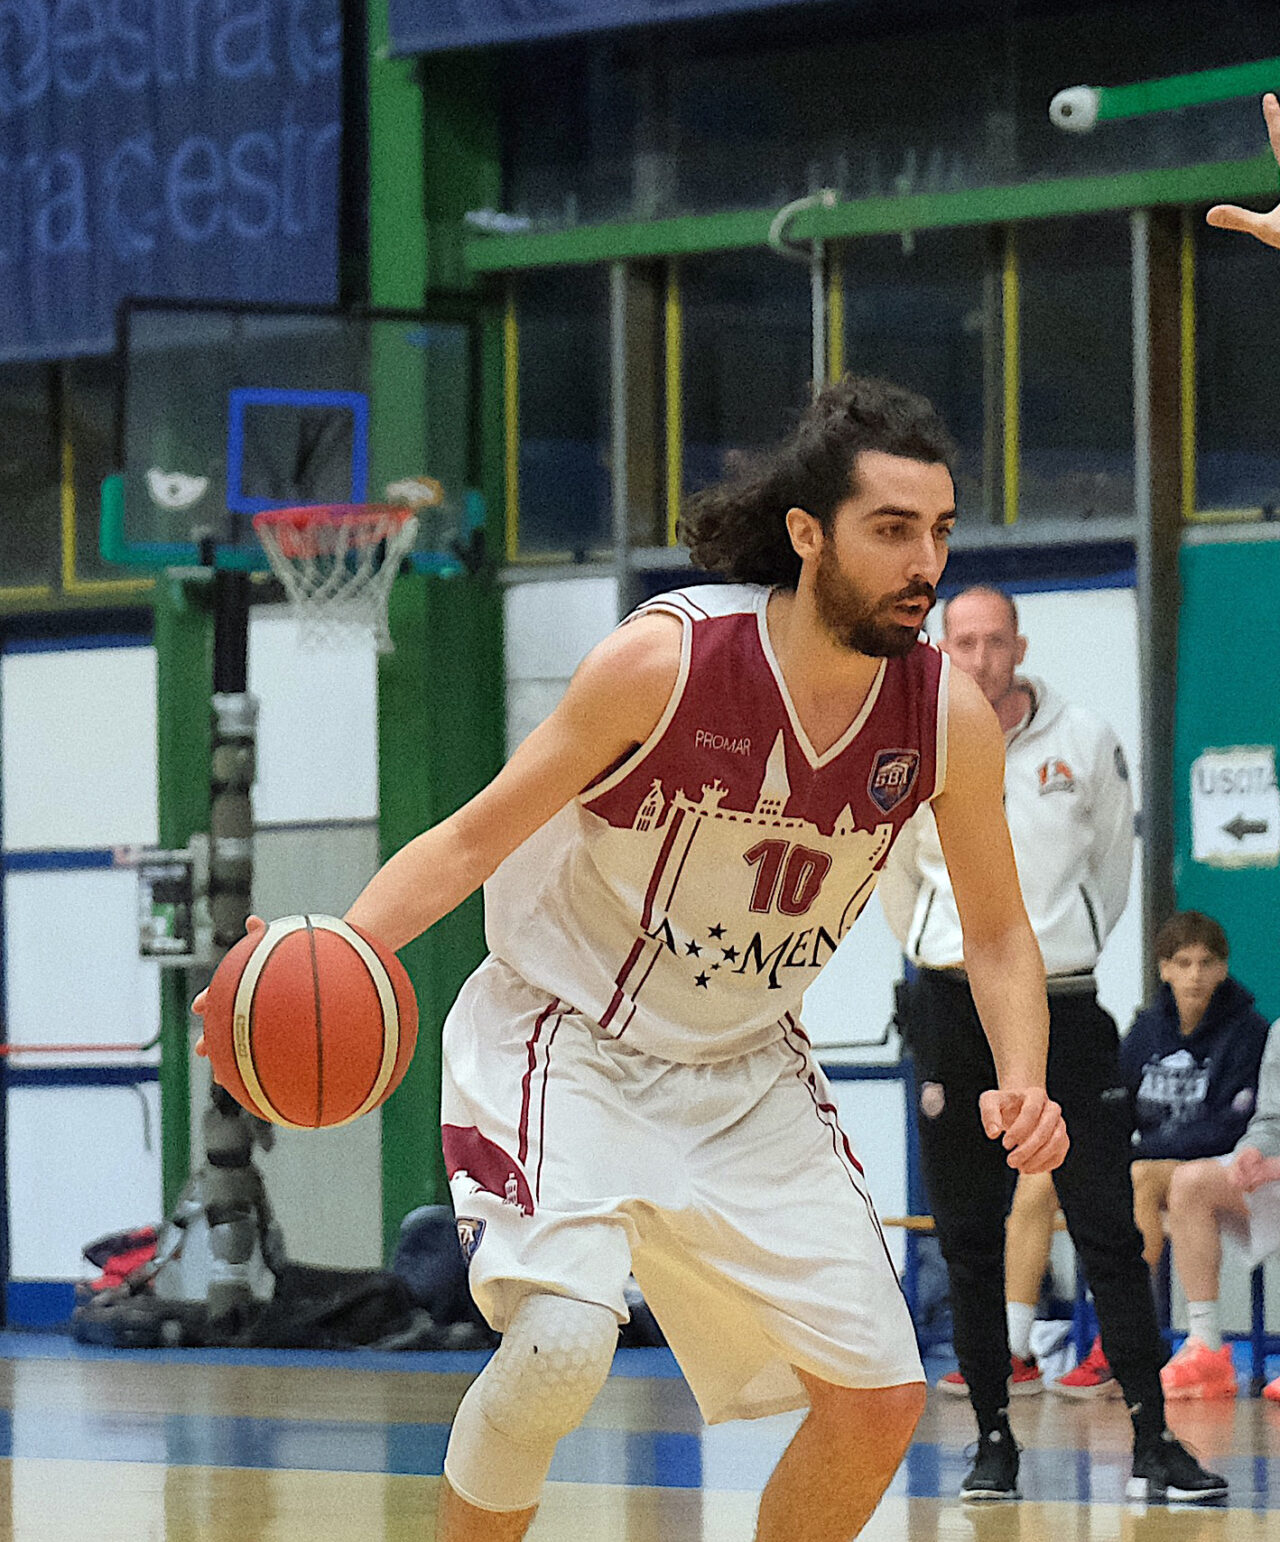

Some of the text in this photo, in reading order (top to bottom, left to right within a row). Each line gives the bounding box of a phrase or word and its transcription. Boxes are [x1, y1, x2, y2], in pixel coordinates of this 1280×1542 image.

[695, 729, 752, 757] PROMAR
[1199, 767, 1277, 795] USCITA
[743, 838, 833, 916] 10
